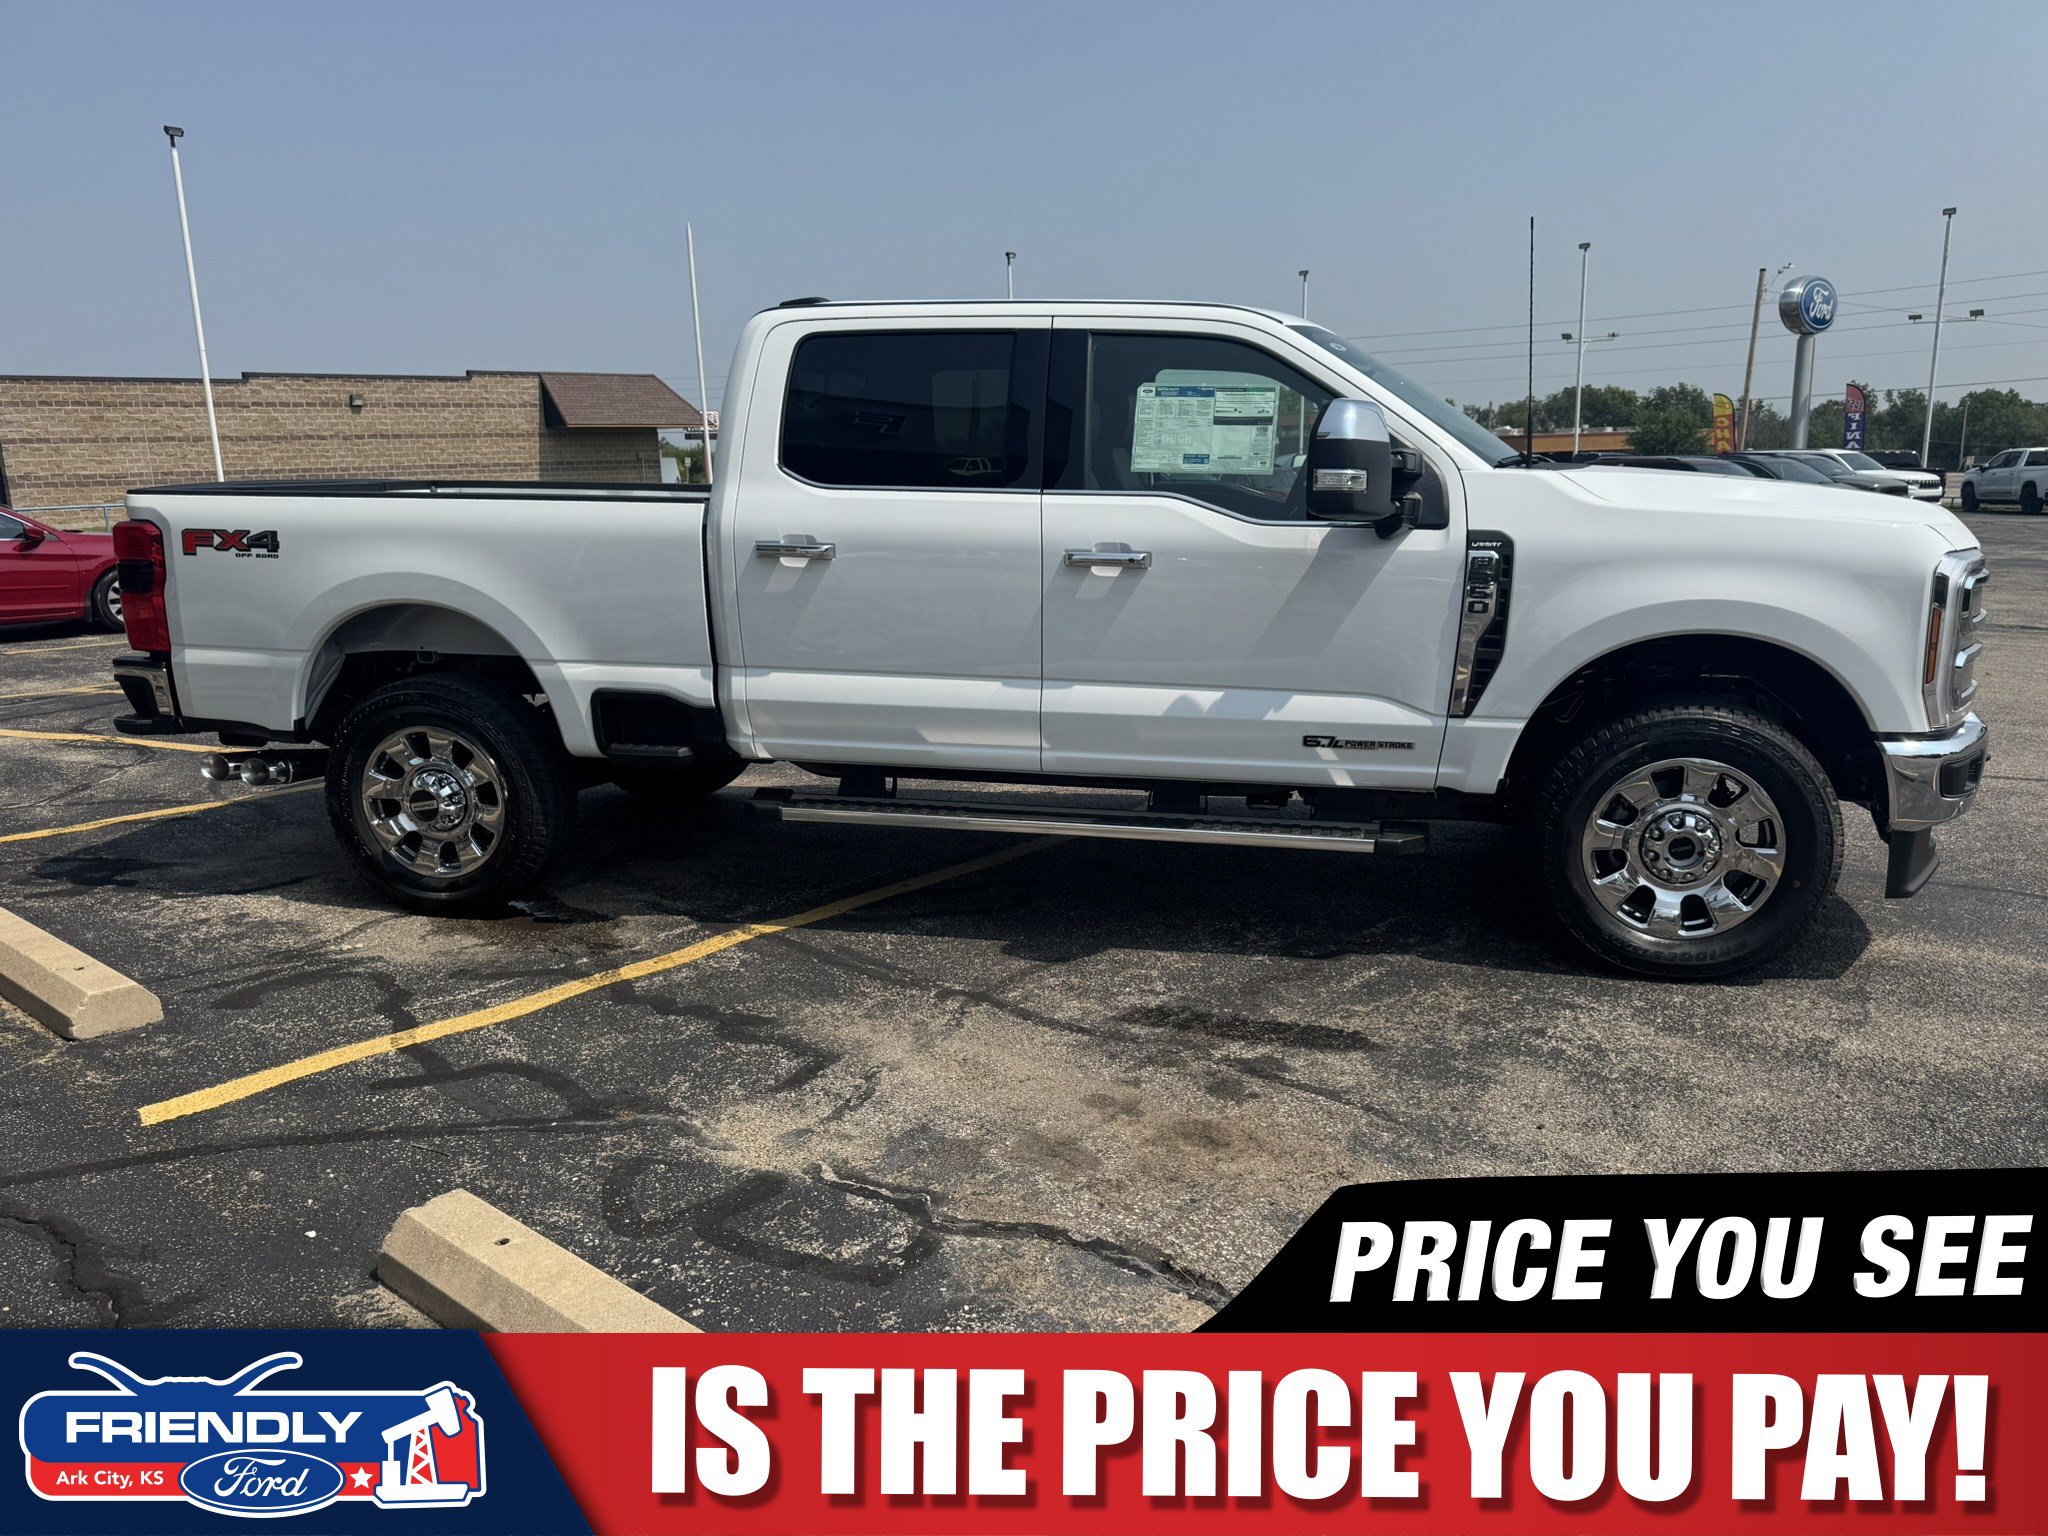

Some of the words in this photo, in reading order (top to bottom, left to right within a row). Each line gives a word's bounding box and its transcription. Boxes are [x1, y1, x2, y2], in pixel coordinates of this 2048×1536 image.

[1809, 286, 1834, 320] Ford
[181, 528, 280, 556] FX4
[1344, 739, 1376, 748] POWER
[1377, 740, 1415, 750] STROKE
